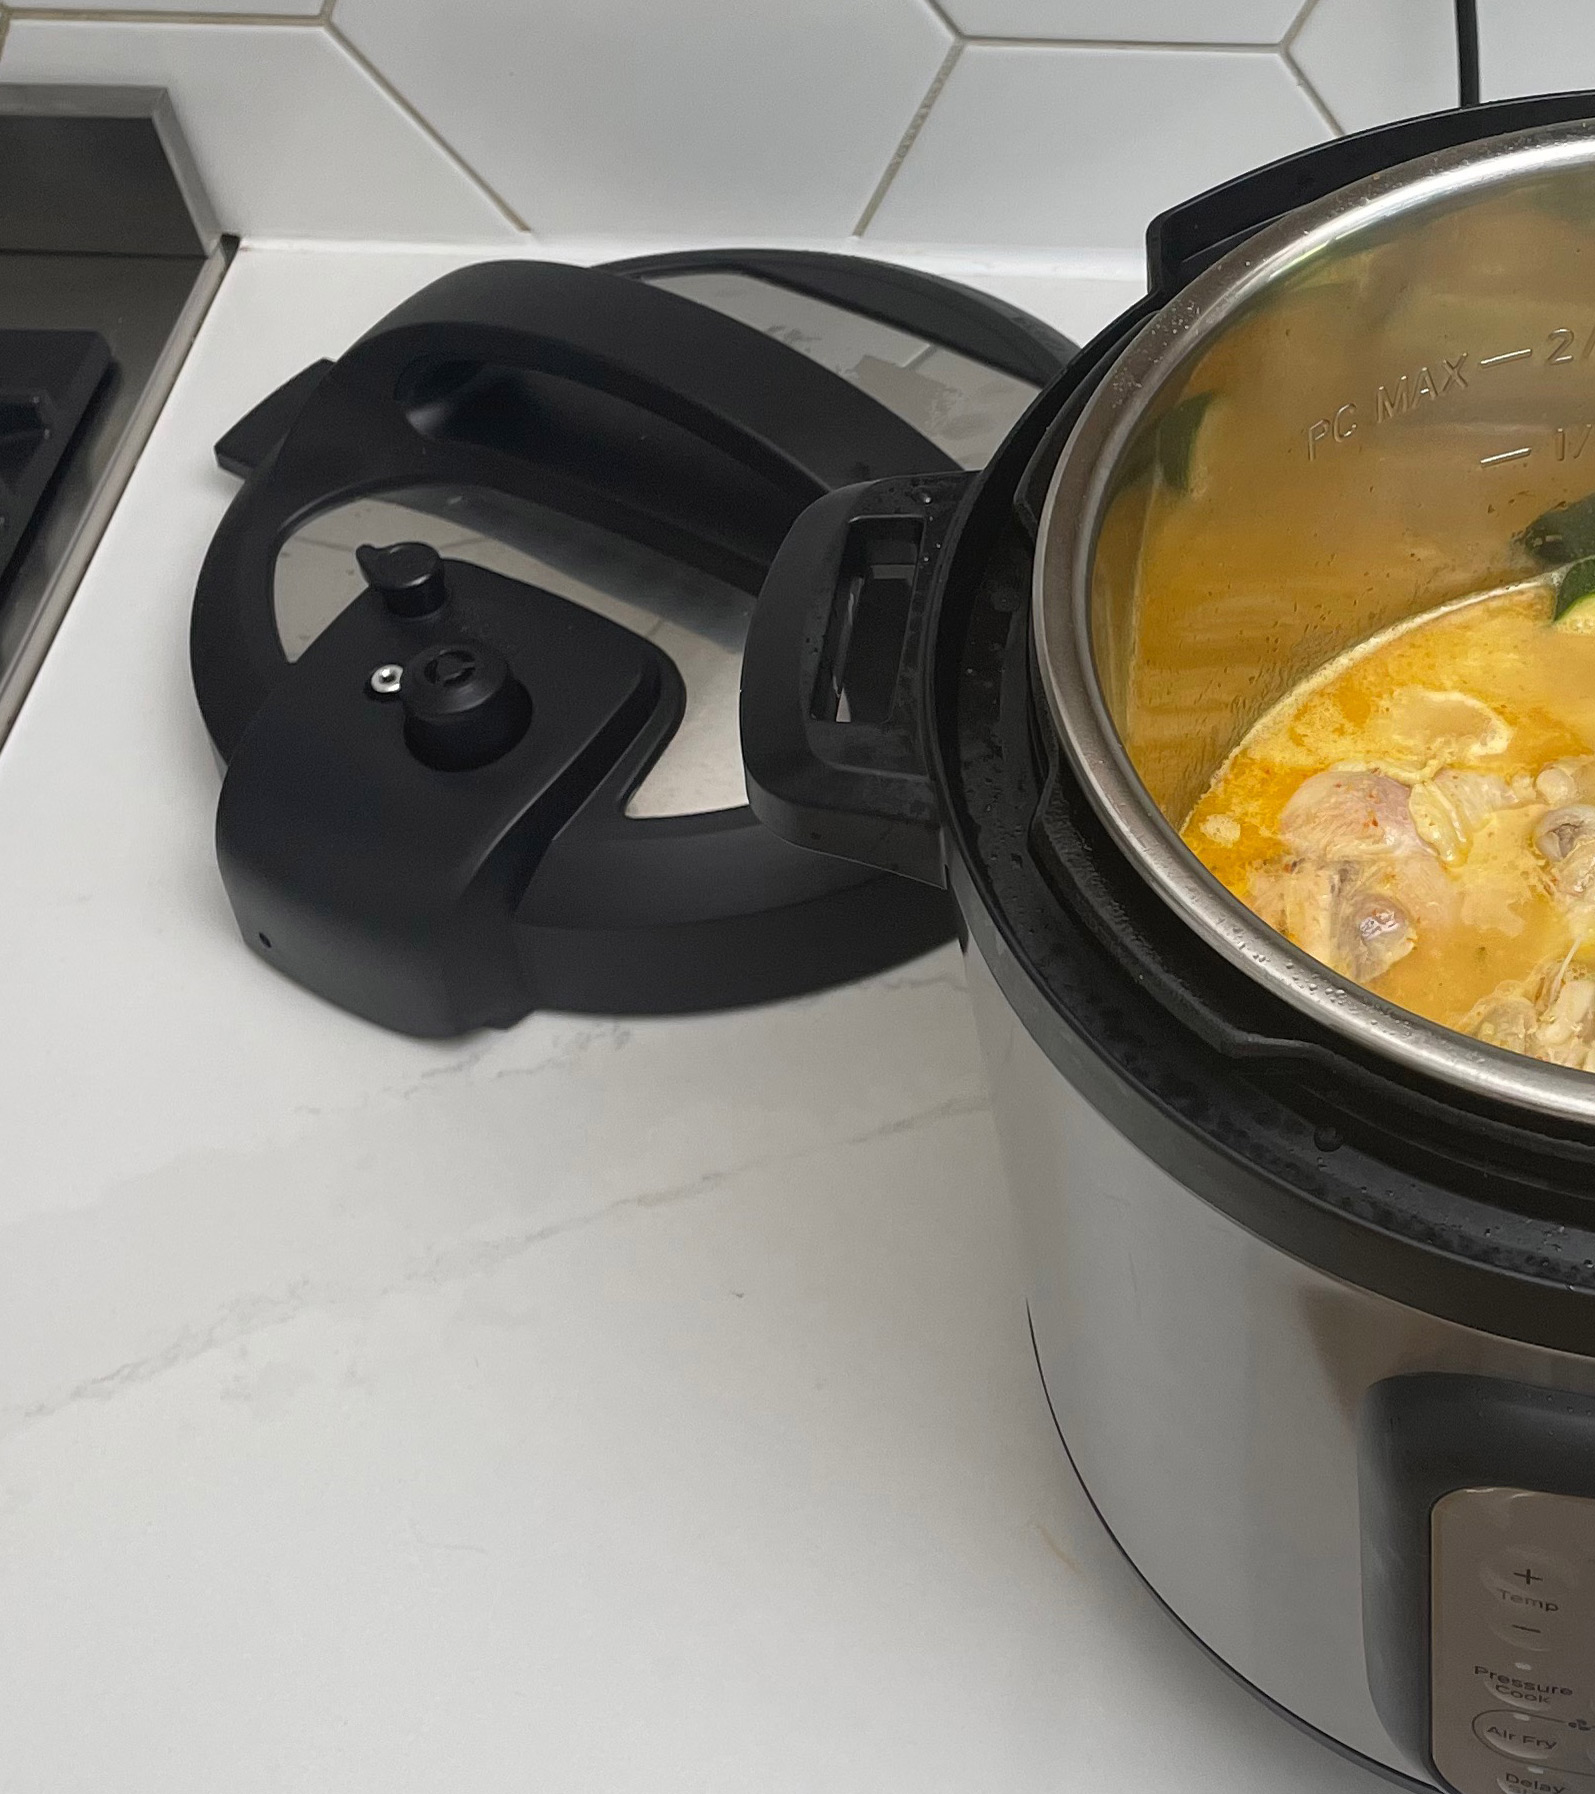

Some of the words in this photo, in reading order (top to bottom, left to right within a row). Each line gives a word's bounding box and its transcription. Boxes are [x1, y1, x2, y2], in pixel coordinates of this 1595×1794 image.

[1306, 402, 1357, 462] PC
[1375, 352, 1469, 424] MAX
[1499, 1588, 1560, 1613] Temp
[1474, 1665, 1574, 1696] Pressure
[1495, 1684, 1551, 1704] Cook
[1486, 1725, 1515, 1741] Air
[1522, 1735, 1558, 1750] Fry
[1505, 1772, 1567, 1794] Delay
